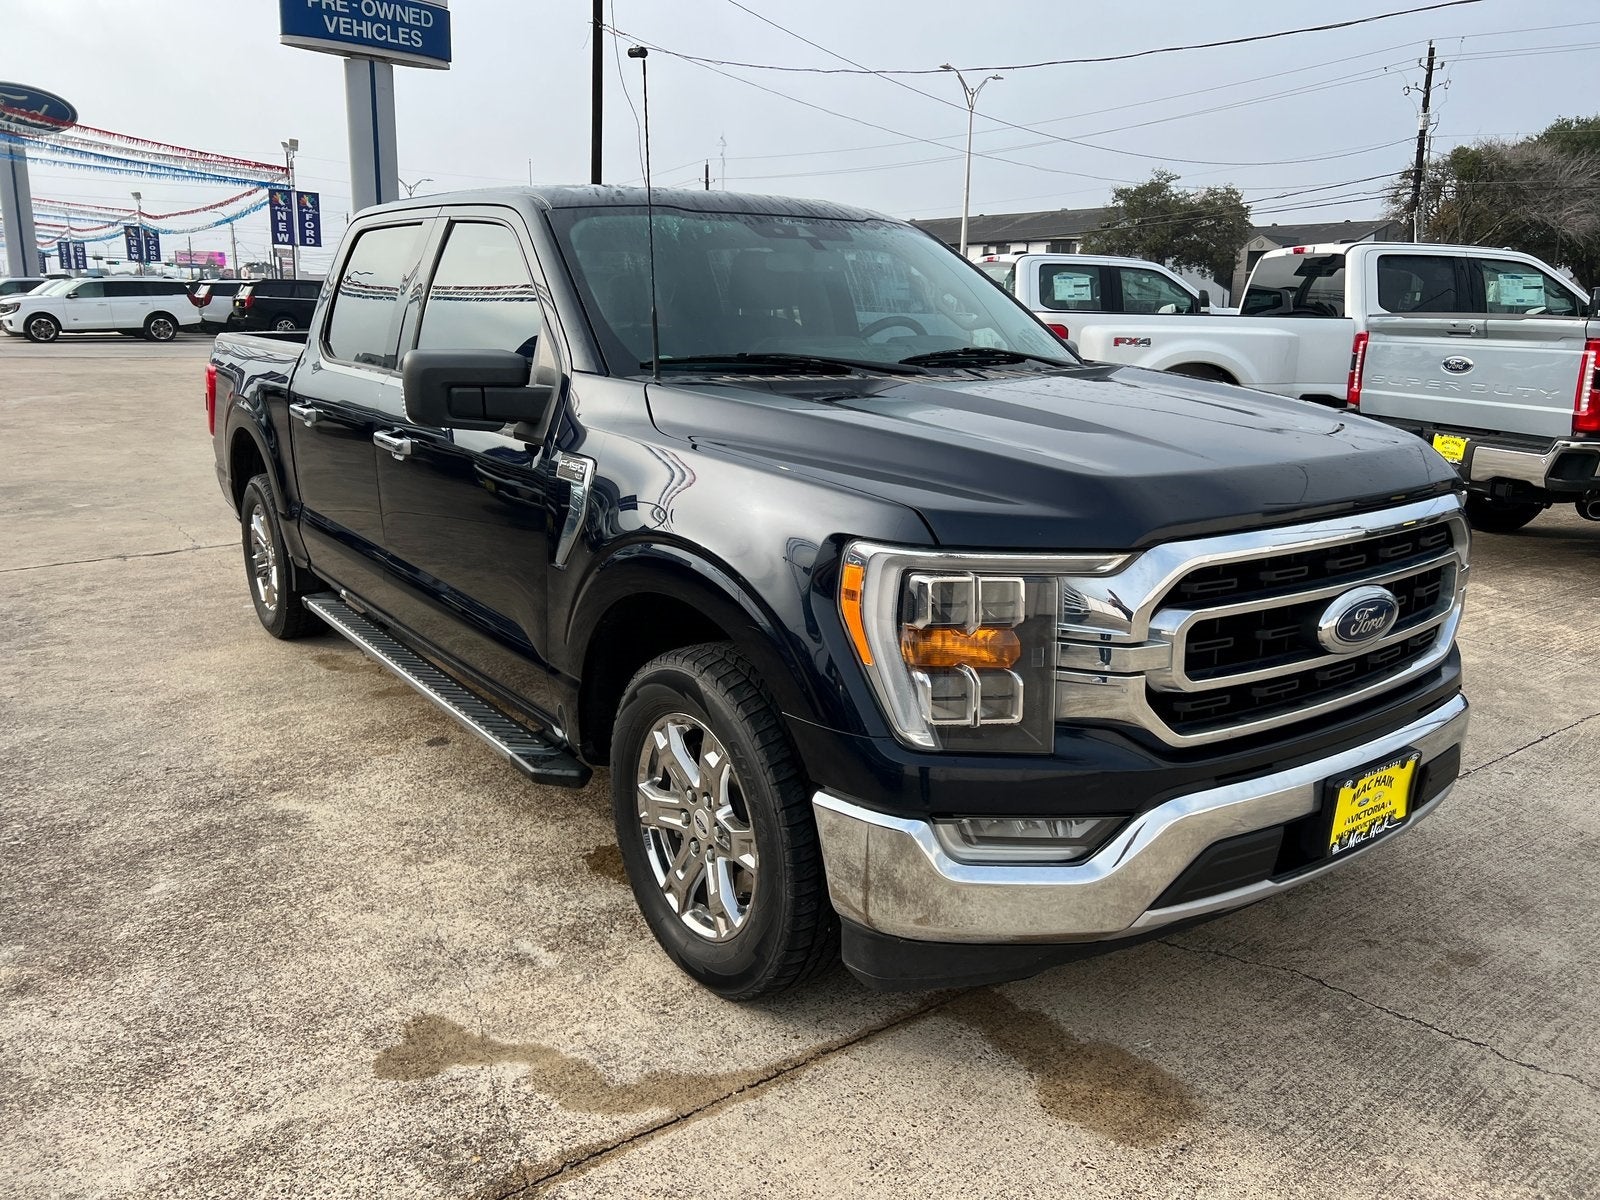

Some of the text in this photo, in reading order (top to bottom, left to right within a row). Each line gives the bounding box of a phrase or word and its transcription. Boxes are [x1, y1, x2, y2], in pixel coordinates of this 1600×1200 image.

[323, 15, 423, 48] VEHICLES
[277, 211, 289, 243] NEW
[304, 213, 315, 245] FORD
[129, 240, 139, 260] NEW
[149, 241, 157, 260] FORD
[1113, 337, 1152, 347] FX4
[1371, 375, 1561, 400] SUPER DUTY
[560, 459, 586, 474] F-150
[1350, 605, 1387, 636] Ford
[1351, 779, 1372, 806] MAC
[1373, 775, 1395, 788] HAIK
[1350, 802, 1386, 824] VICTORIA
[1347, 815, 1399, 848] Mac Haik
